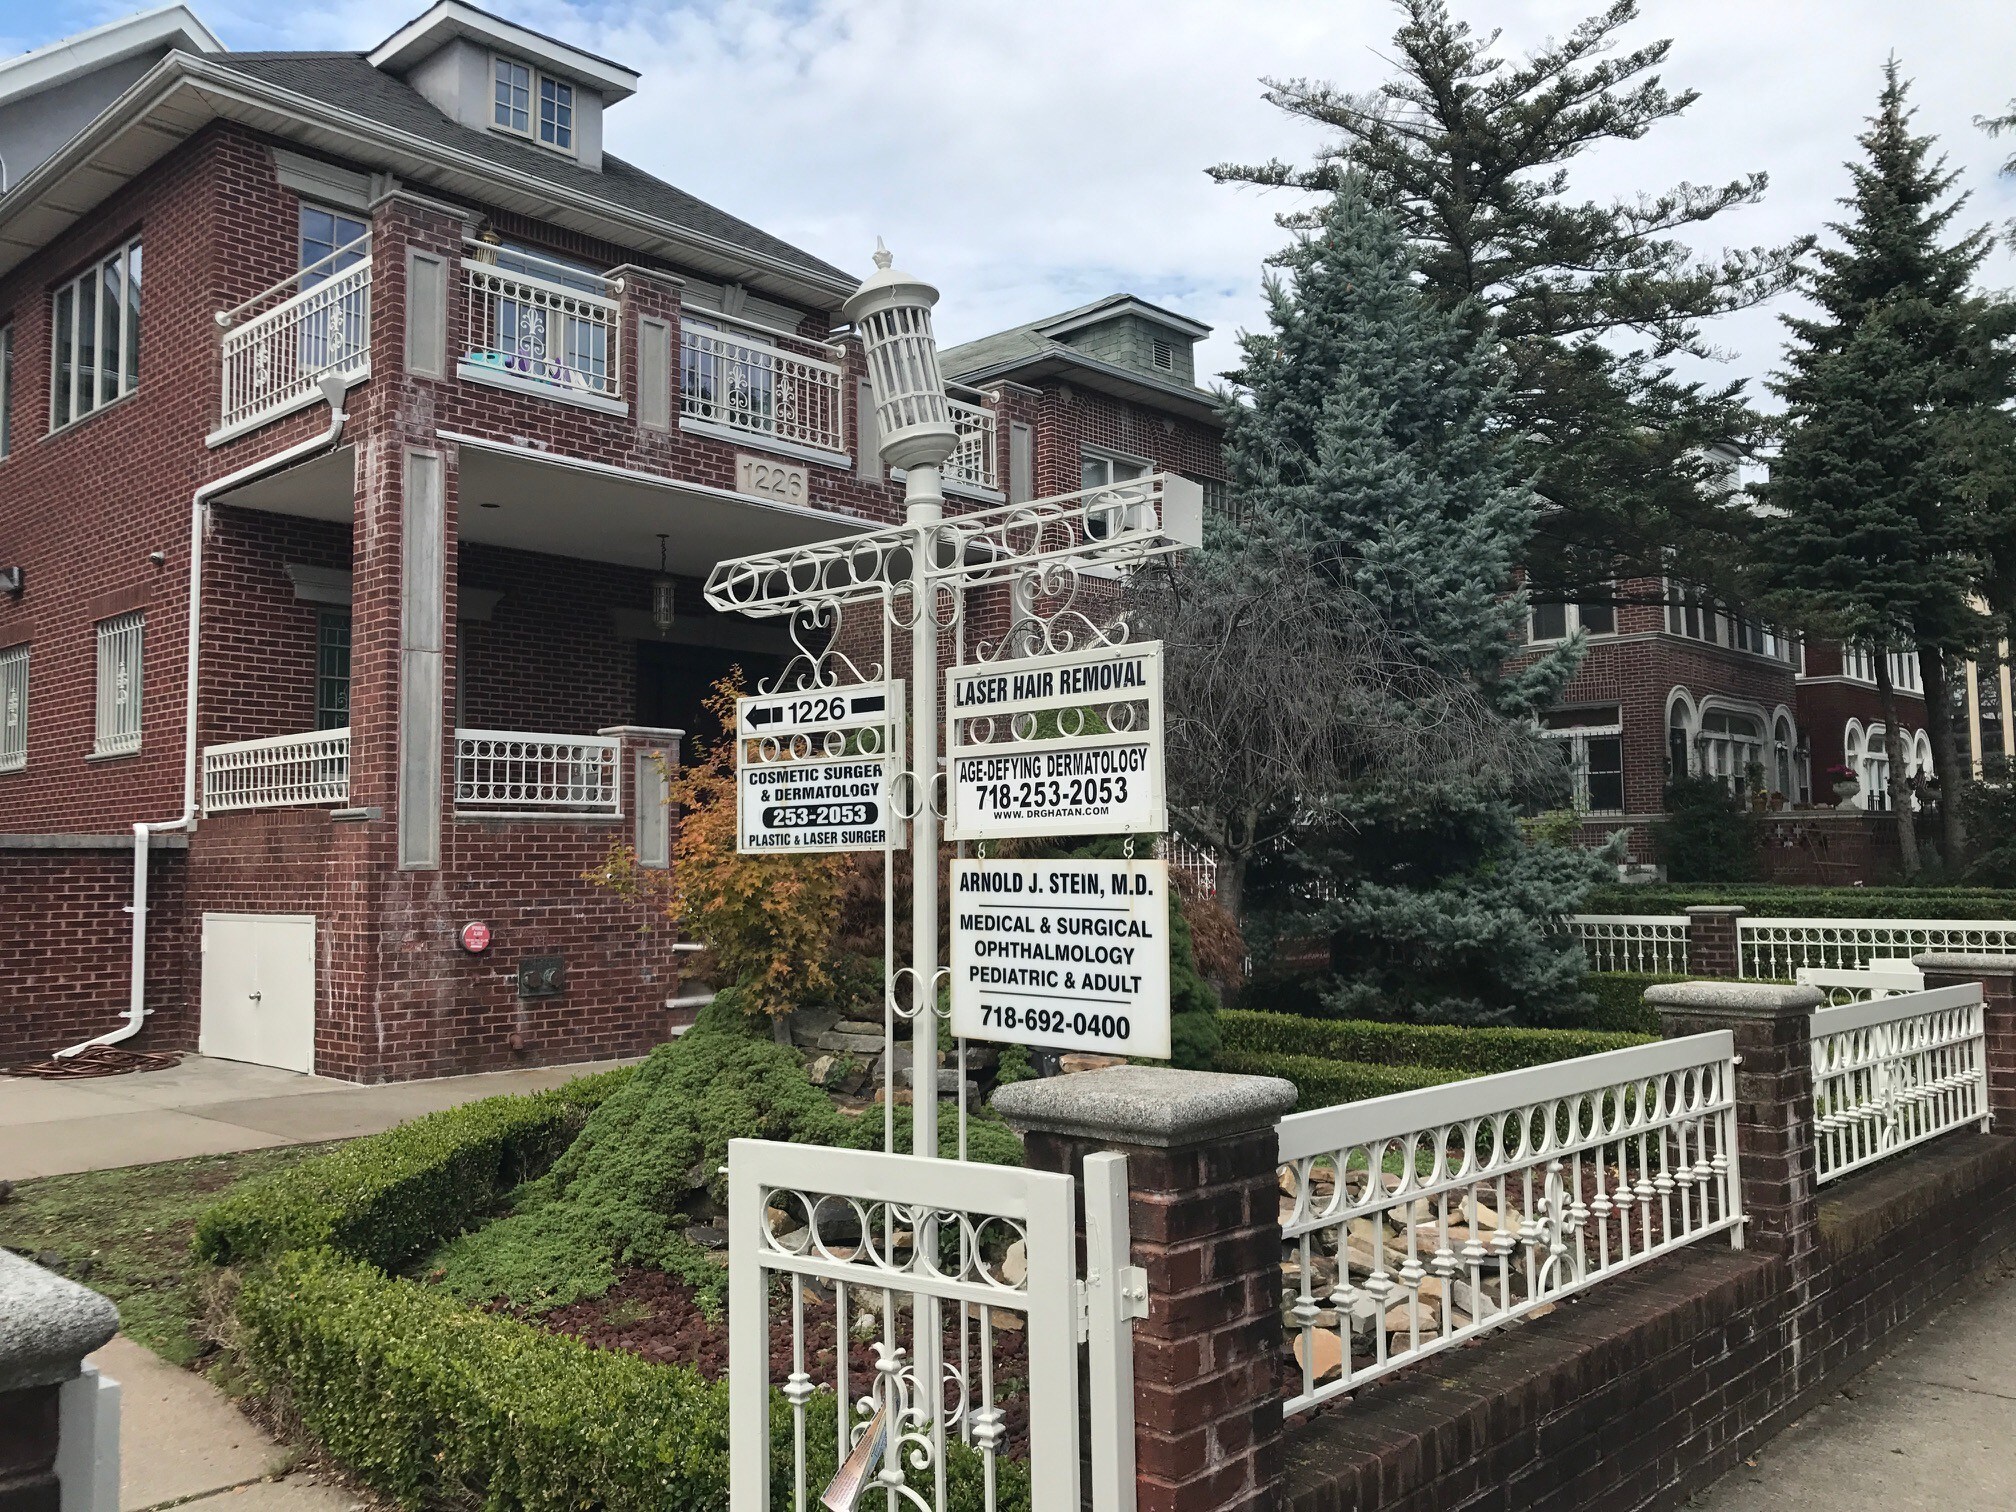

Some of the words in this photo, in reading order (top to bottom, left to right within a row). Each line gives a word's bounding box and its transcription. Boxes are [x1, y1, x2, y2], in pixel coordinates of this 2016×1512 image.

[743, 462, 802, 498] 1226
[956, 677, 1008, 707] LASER
[1013, 672, 1053, 700] HAIR
[1059, 660, 1146, 695] REMOVAL
[788, 696, 846, 724] 1226
[749, 768, 819, 785] COSMETIC
[823, 764, 884, 780] SURGER
[959, 756, 1042, 783] AGE-DEFYING
[1046, 748, 1148, 777] DERMATOLOGY
[760, 789, 771, 802] &
[774, 783, 880, 801] DERMATOLOGY
[976, 776, 1128, 810] 718-253-2053
[773, 804, 867, 827] 253-2053
[749, 833, 791, 847] PLASTIC
[794, 835, 801, 845] &
[803, 831, 838, 845] LASER
[841, 829, 886, 843] SURGER
[959, 872, 1023, 893] ARNOLD
[1028, 873, 1043, 894] J.
[1049, 873, 1105, 899] STEIN,
[1111, 873, 1154, 896] M.D.
[960, 914, 1035, 933] MEDICAL
[1040, 916, 1051, 934] &
[1057, 917, 1153, 938] SURGICAL
[974, 940, 1135, 965] OPHTHALMOLOGY
[969, 965, 1059, 988] PEDIATRIC
[1064, 971, 1076, 989] &
[1081, 973, 1142, 994] ADULT
[980, 1004, 1131, 1040] 718-692-0400
